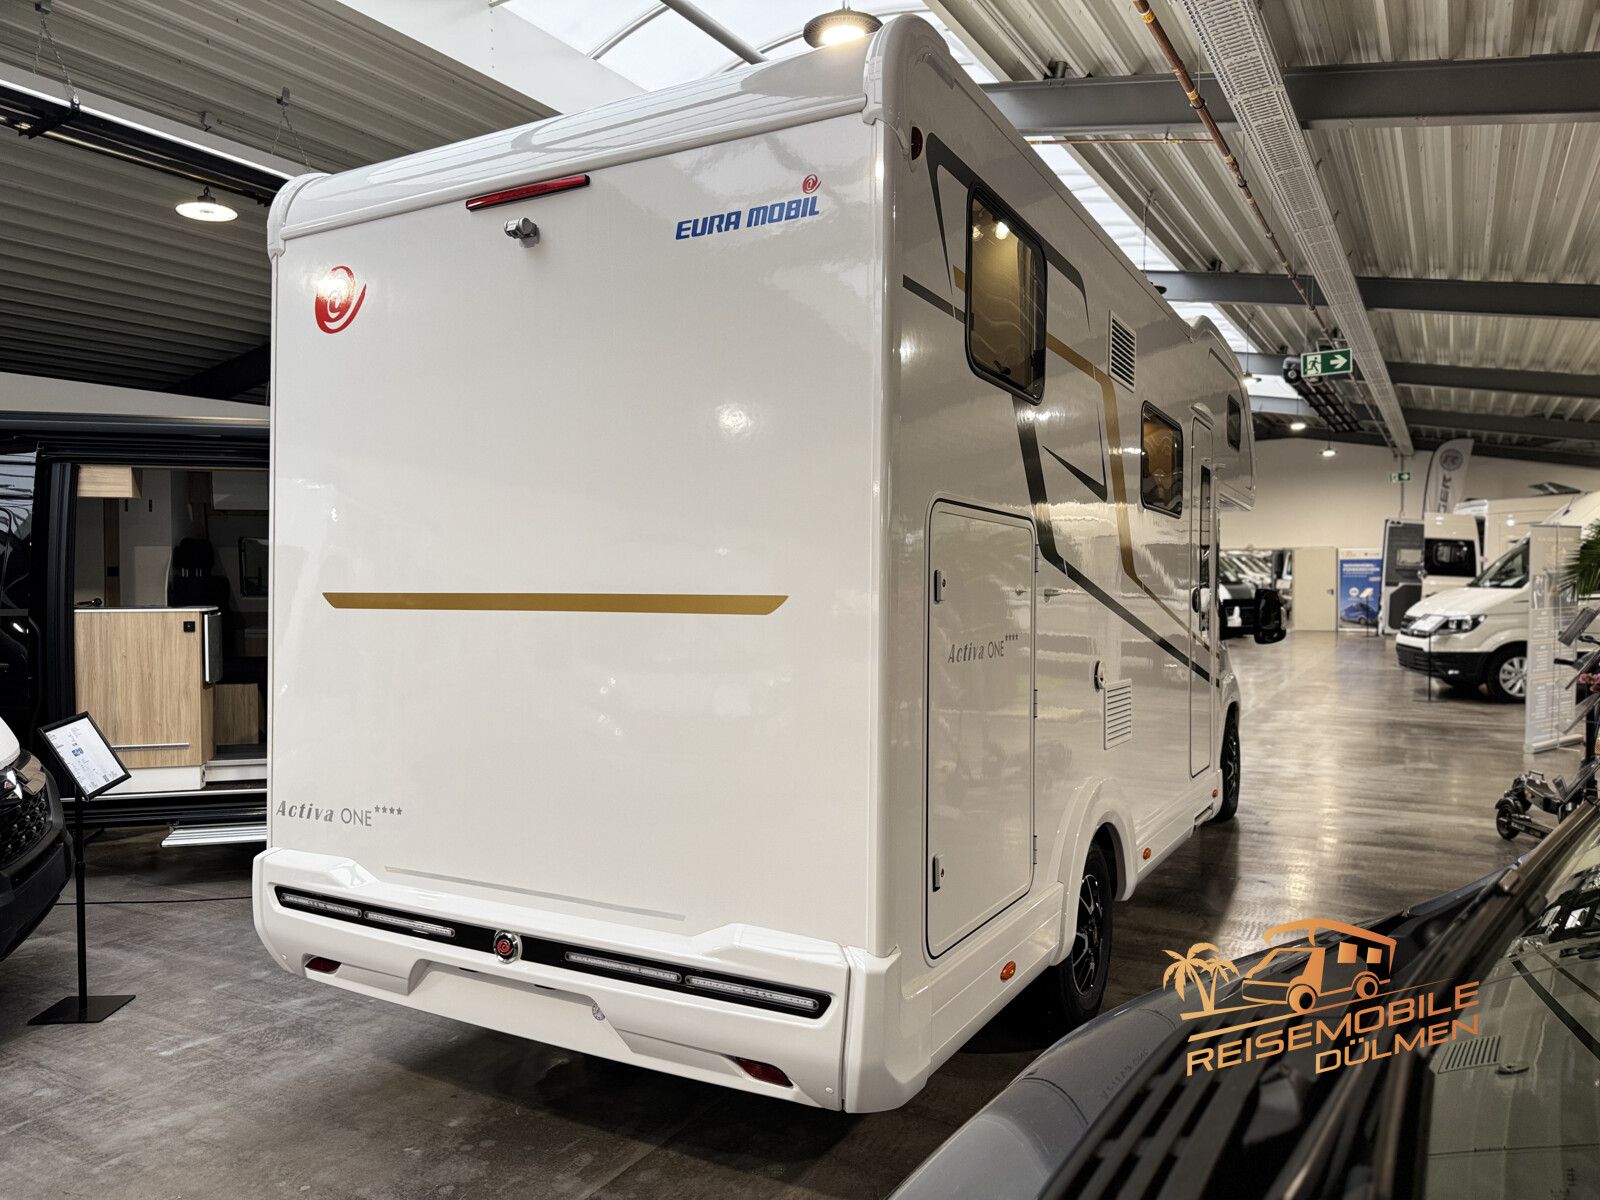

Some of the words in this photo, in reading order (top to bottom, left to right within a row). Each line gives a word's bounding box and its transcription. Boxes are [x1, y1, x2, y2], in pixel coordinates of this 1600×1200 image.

[675, 211, 742, 240] EURA
[747, 195, 820, 228] MOBIL
[947, 642, 985, 663] Activa
[276, 800, 334, 822] Activa
